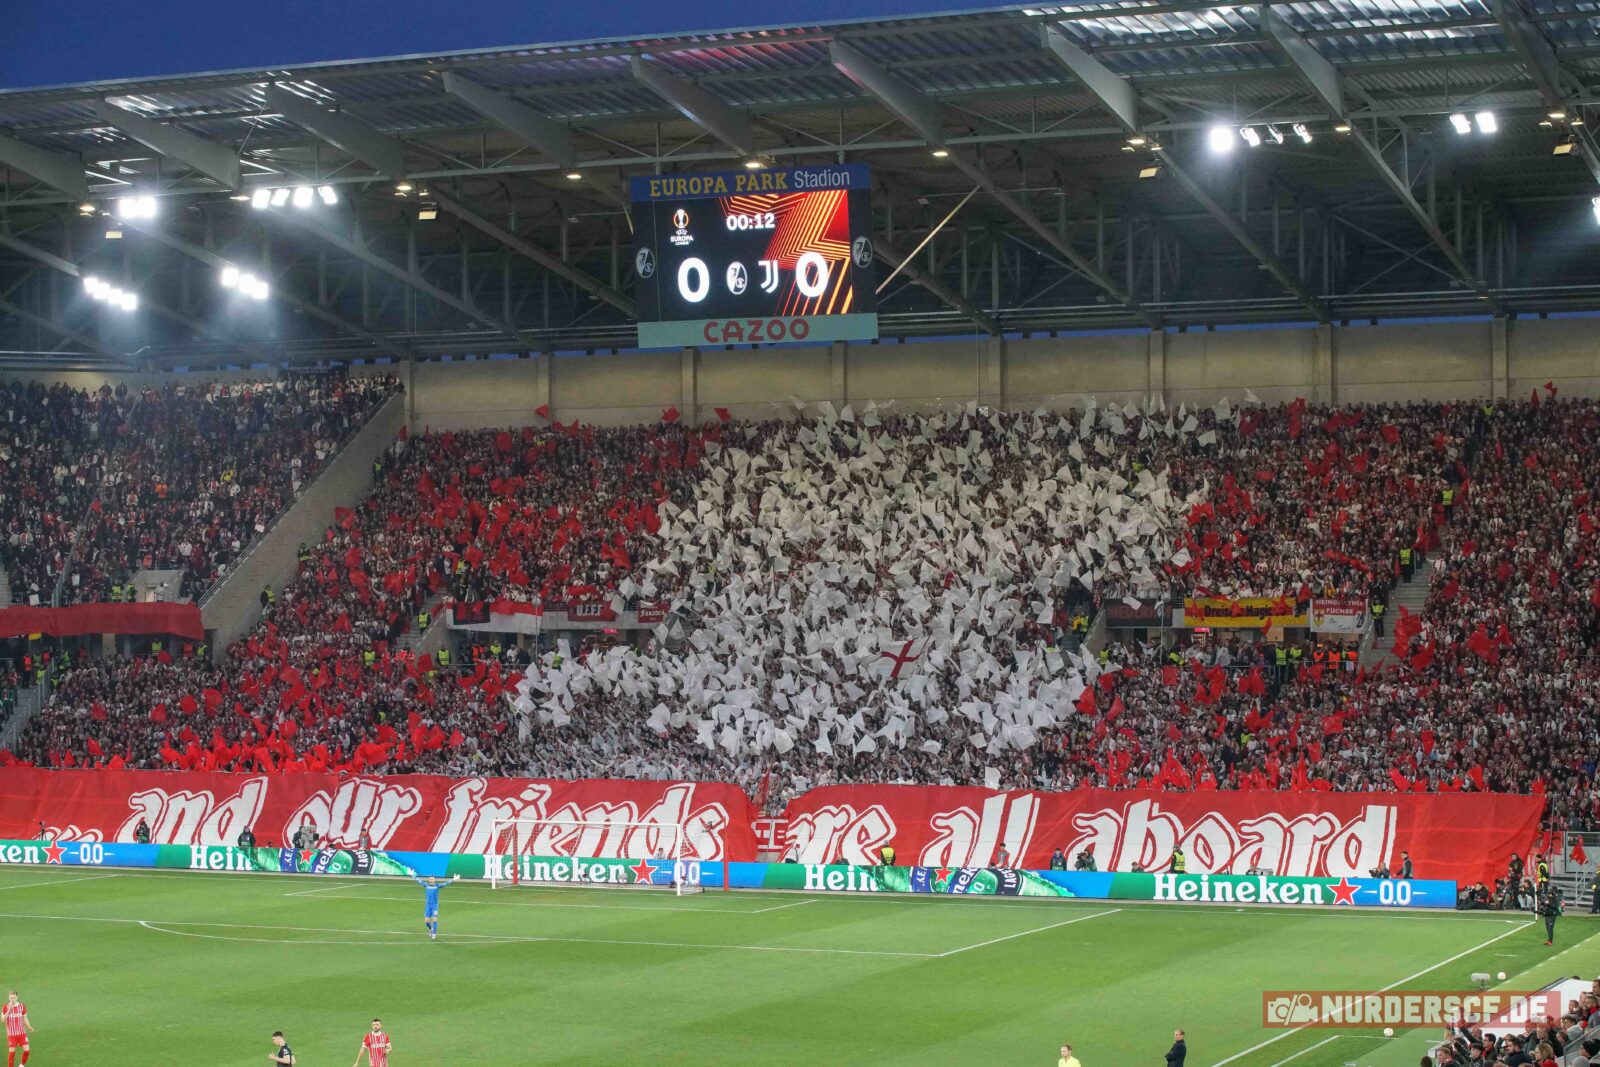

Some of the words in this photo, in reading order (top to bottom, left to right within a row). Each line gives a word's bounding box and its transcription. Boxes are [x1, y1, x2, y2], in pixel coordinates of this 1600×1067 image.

[650, 175, 728, 197] EUROPA
[736, 172, 788, 192] PARK
[794, 169, 850, 189] Stadion
[726, 213, 776, 231] 00:12
[670, 234, 694, 243] EUROPA
[677, 257, 710, 302] 0
[795, 251, 829, 297] 0
[704, 319, 810, 343] CAZOO
[113, 776, 268, 846] and
[283, 777, 422, 850] our
[429, 777, 730, 862] friends
[777, 804, 897, 866] are
[918, 793, 1041, 870] all
[1063, 798, 1398, 878] aboard
[483, 854, 627, 884] Heineken
[1153, 874, 1324, 904] Heineken
[1379, 881, 1411, 905] 0.0
